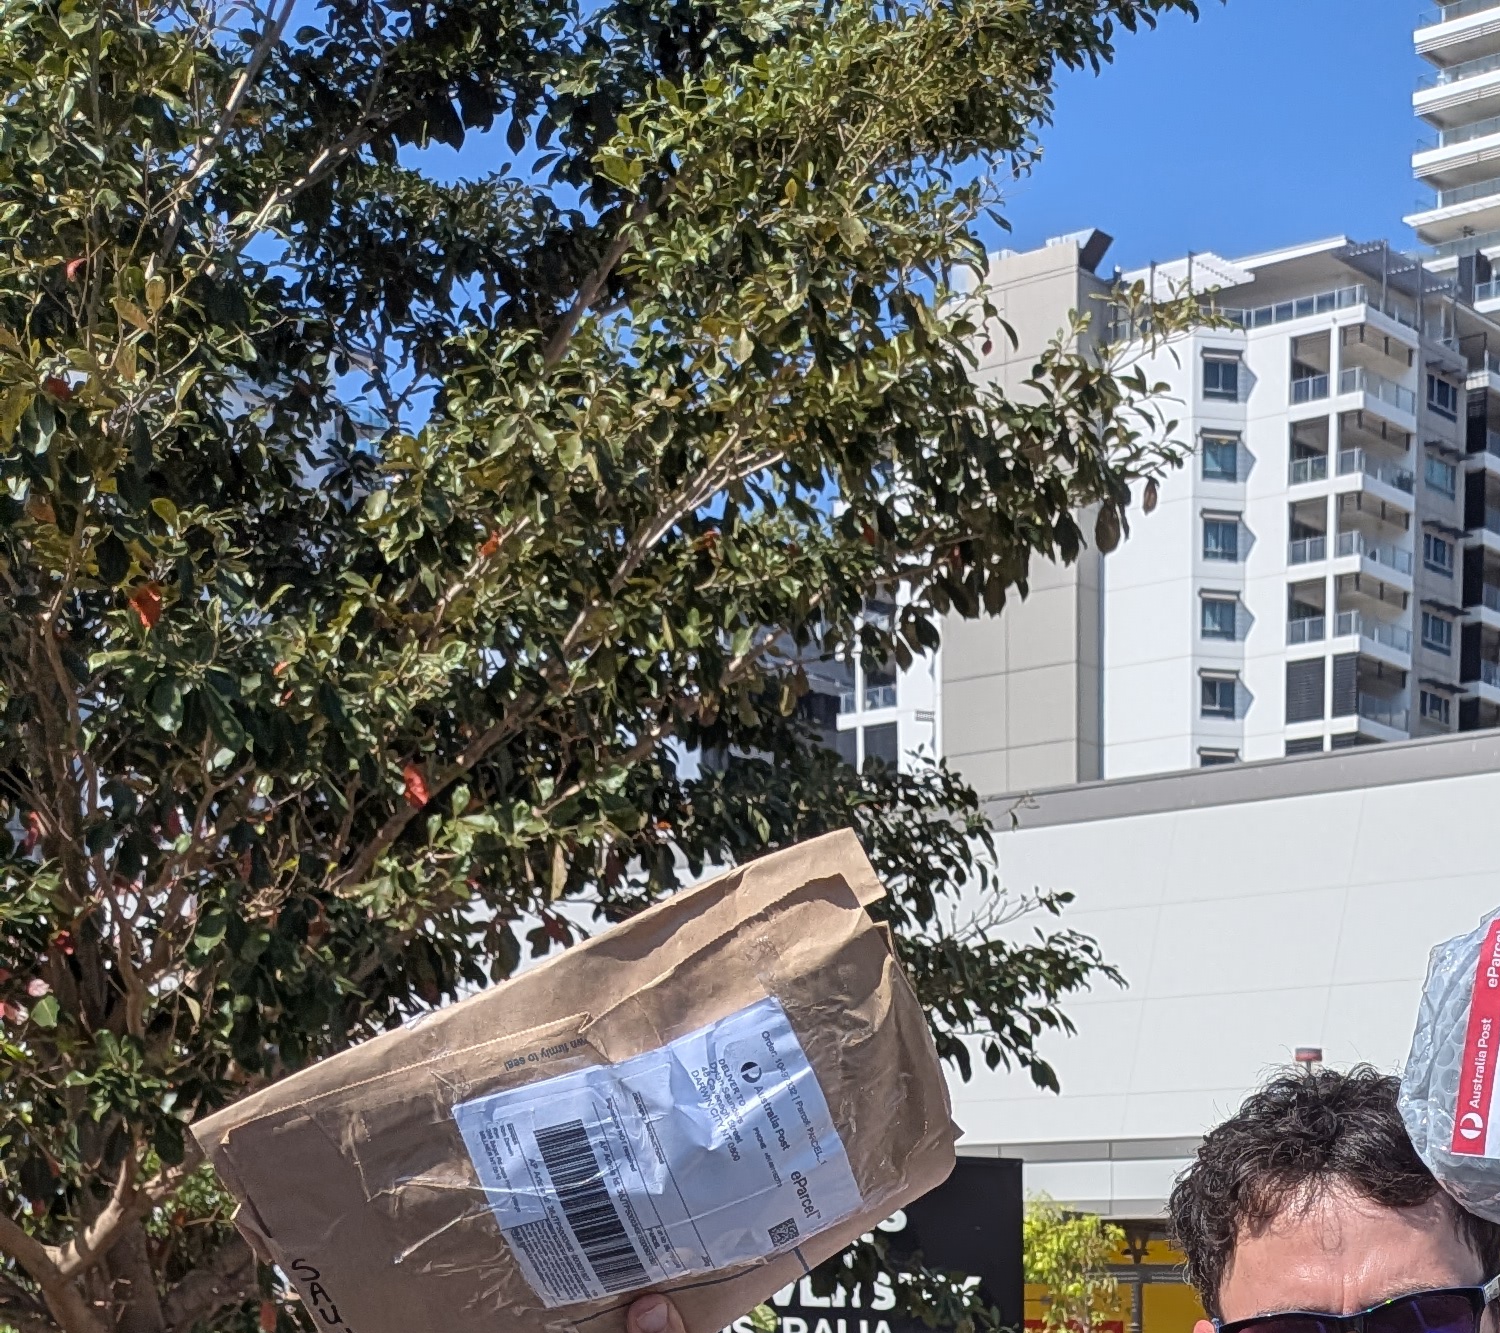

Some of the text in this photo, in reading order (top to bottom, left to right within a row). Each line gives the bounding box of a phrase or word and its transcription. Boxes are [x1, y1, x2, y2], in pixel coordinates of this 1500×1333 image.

[527, 1051, 539, 1063] to
[539, 1042, 569, 1060] firmly
[503, 1056, 525, 1071] seal
[1468, 1017, 1491, 1108] Australia Post
[708, 1061, 725, 1086] Dylan
[717, 1057, 746, 1107] DELIVER TO
[691, 1069, 714, 1107] DARWIN
[709, 1106, 725, 1129] CITY
[700, 1065, 710, 1077] 48
[726, 1118, 743, 1144] Street
[753, 1084, 791, 1151] Australia Post
[598, 1139, 608, 1152] AP
[616, 1129, 627, 1145] NOT
[527, 1157, 538, 1170] AP
